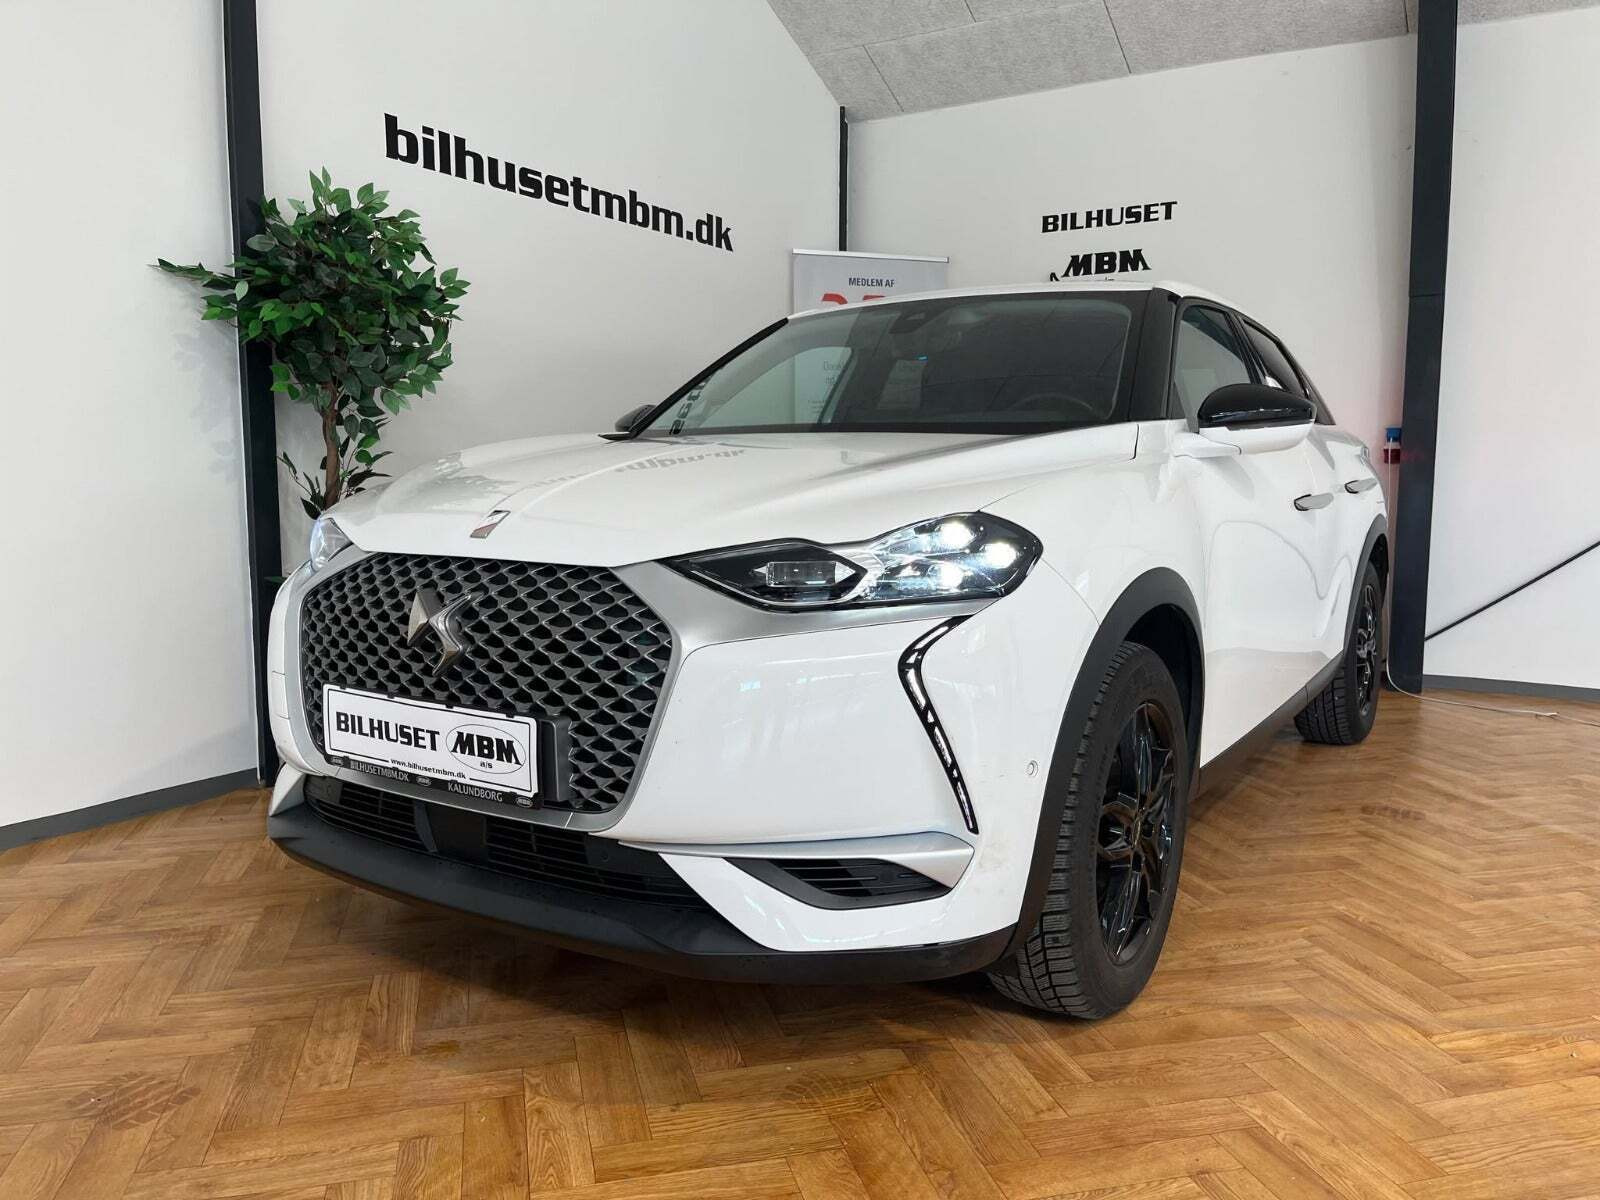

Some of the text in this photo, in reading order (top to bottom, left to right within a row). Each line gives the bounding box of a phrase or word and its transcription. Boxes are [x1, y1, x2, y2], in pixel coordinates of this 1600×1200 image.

[384, 113, 733, 252] bilhusetmbm.dk
[1041, 201, 1177, 233] BILHUSET
[1061, 248, 1152, 278] MBM
[848, 277, 895, 288] MEDLEM AF
[336, 711, 524, 766] BILHUSET MBM
[350, 760, 409, 782] BILHUSETMBM.DK
[390, 758, 466, 779] www.bilhusetmbm.dk
[479, 761, 493, 769] a/s
[447, 782, 503, 802] KALUNDBORG
